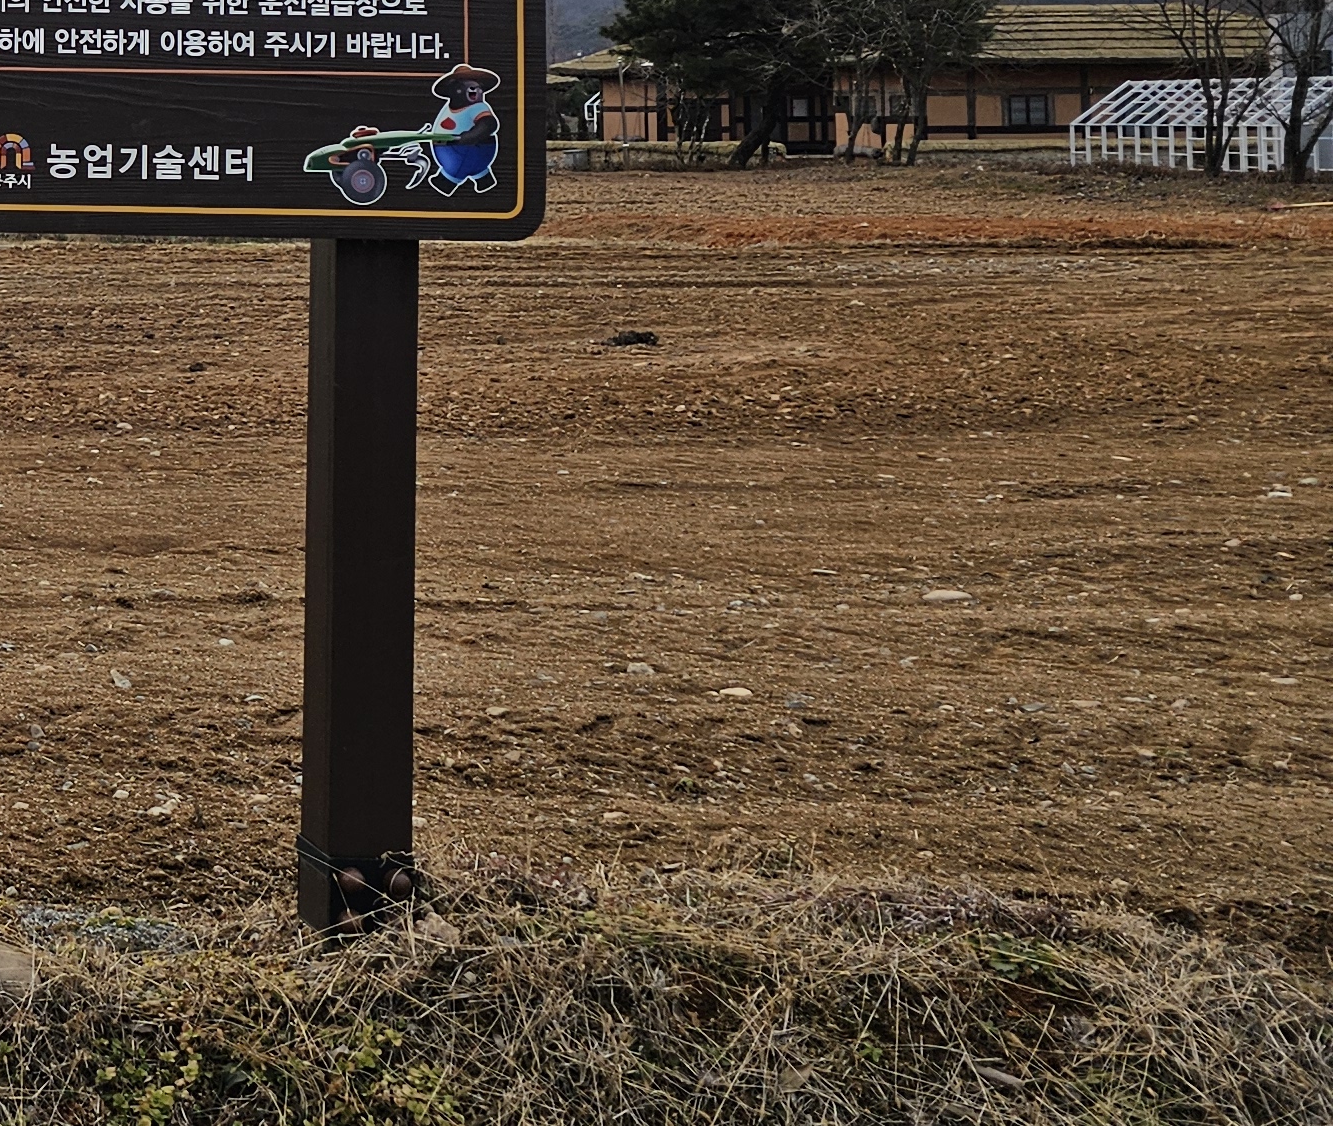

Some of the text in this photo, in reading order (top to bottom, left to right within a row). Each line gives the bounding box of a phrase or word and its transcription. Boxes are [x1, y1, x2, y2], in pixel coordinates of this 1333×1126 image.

[54, 28, 150, 56] 안전하게
[160, 29, 255, 57] 이용하여
[263, 31, 336, 58] 주시기
[346, 31, 450, 60] 바랍니다.
[46, 143, 253, 182] 농업기술센터
